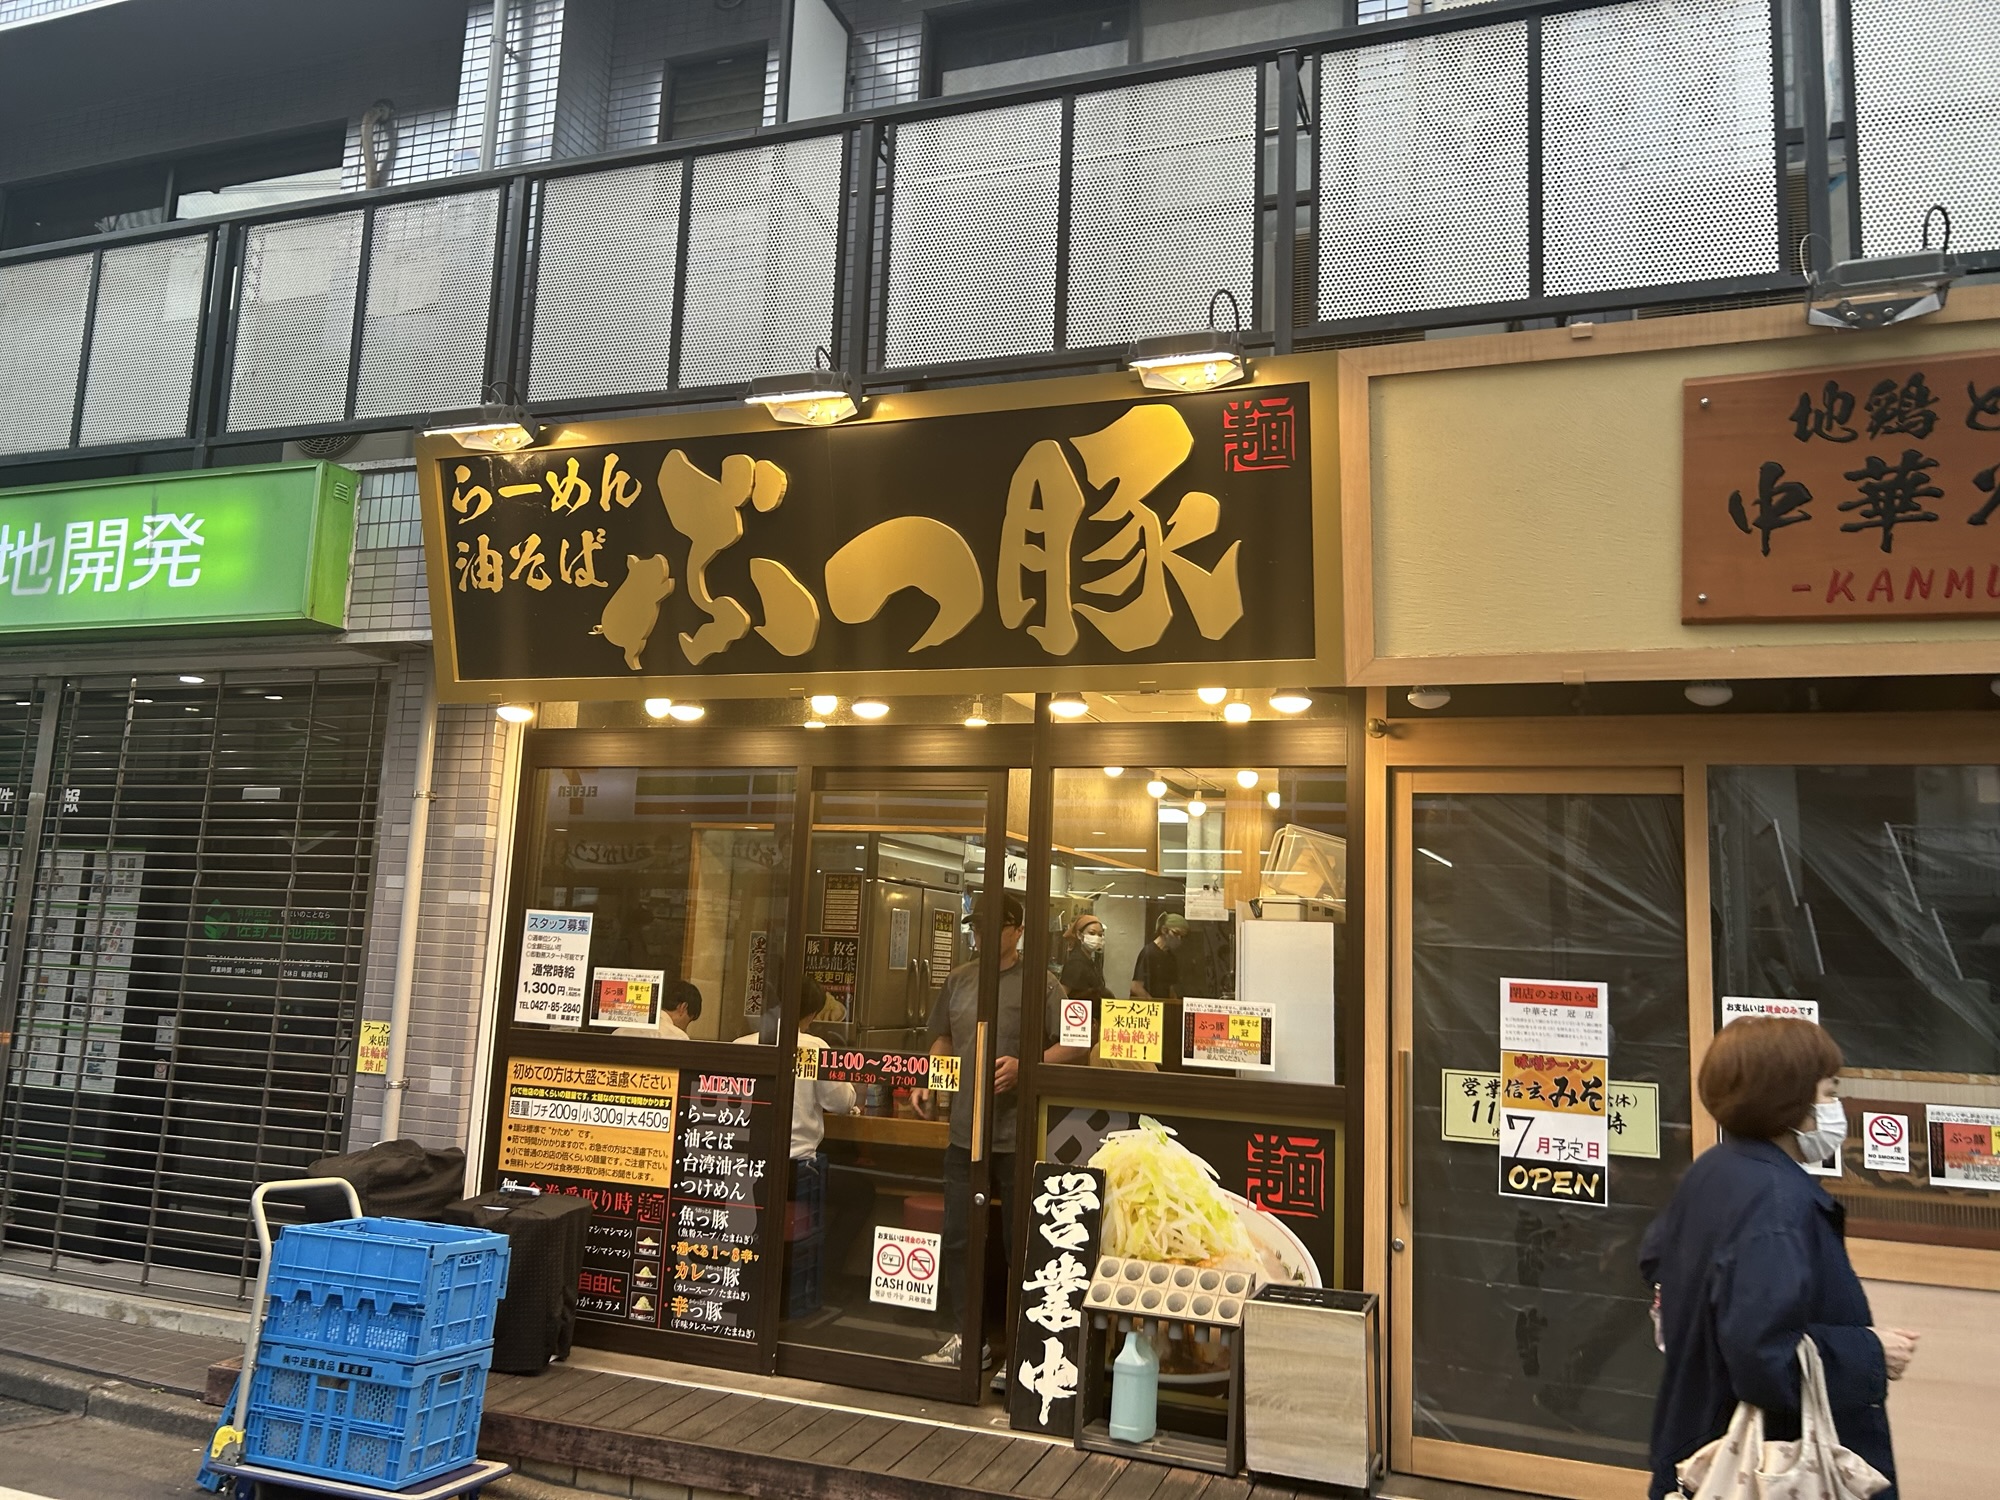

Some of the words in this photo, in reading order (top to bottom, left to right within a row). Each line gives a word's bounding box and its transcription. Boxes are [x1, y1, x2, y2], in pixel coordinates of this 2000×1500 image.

[451, 453, 642, 524] らーめん
[658, 404, 1244, 667] ぶっ豚
[0, 513, 205, 596] 地開発
[455, 528, 609, 593] 油そば
[529, 917, 588, 932] スタッフ募集
[531, 963, 576, 978] 通常時給
[523, 981, 566, 996] 1,300円
[604, 987, 624, 996] ぶっ豚
[1510, 986, 1598, 1004] 閉店のお知らせ
[519, 1001, 529, 1010] TEL
[1105, 1001, 1160, 1016] ラーメン店
[1522, 1007, 1558, 1017] 中華そば
[1584, 1010, 1594, 1019] 店
[1726, 1002, 1814, 1016] お支払いは現金のみです
[1113, 1015, 1151, 1029] 来店時
[1199, 1020, 1225, 1031] ぶっ豚
[1231, 1019, 1260, 1028] 中華そば
[1103, 1028, 1160, 1045] 駐輪絶対
[1110, 1043, 1147, 1060] 禁止！
[363, 1059, 384, 1072] 禁止
[820, 1050, 929, 1075] 11:00～23:00
[1514, 1054, 1594, 1073] 味噌ラーメン
[513, 1063, 672, 1091] 初めての方は大盛ご遠慮ください
[828, 1071, 846, 1081] 休憩
[930, 1073, 958, 1089] 無休
[698, 1075, 757, 1096] MENU
[1504, 1075, 1603, 1112] 信玄みそ
[510, 1100, 530, 1117] 麺量
[688, 1105, 750, 1127] らーめん
[684, 1128, 735, 1150] 油そば
[1950, 1132, 1986, 1147] ぶっ豚
[683, 1152, 767, 1178] 台湾油そば
[680, 1179, 746, 1200] つけめん
[1508, 1164, 1600, 1197] OPEN
[678, 1205, 730, 1230] 魚っ豚
[878, 1232, 938, 1247] お支払いは現金のみです
[578, 1272, 622, 1293] 自由に
[674, 1261, 740, 1288] カレっ豚
[875, 1276, 904, 1290] CASH
[906, 1281, 934, 1294] ONLY
[1018, 1171, 1100, 1426] 営業中
[671, 1295, 723, 1322] 辛っ豚
